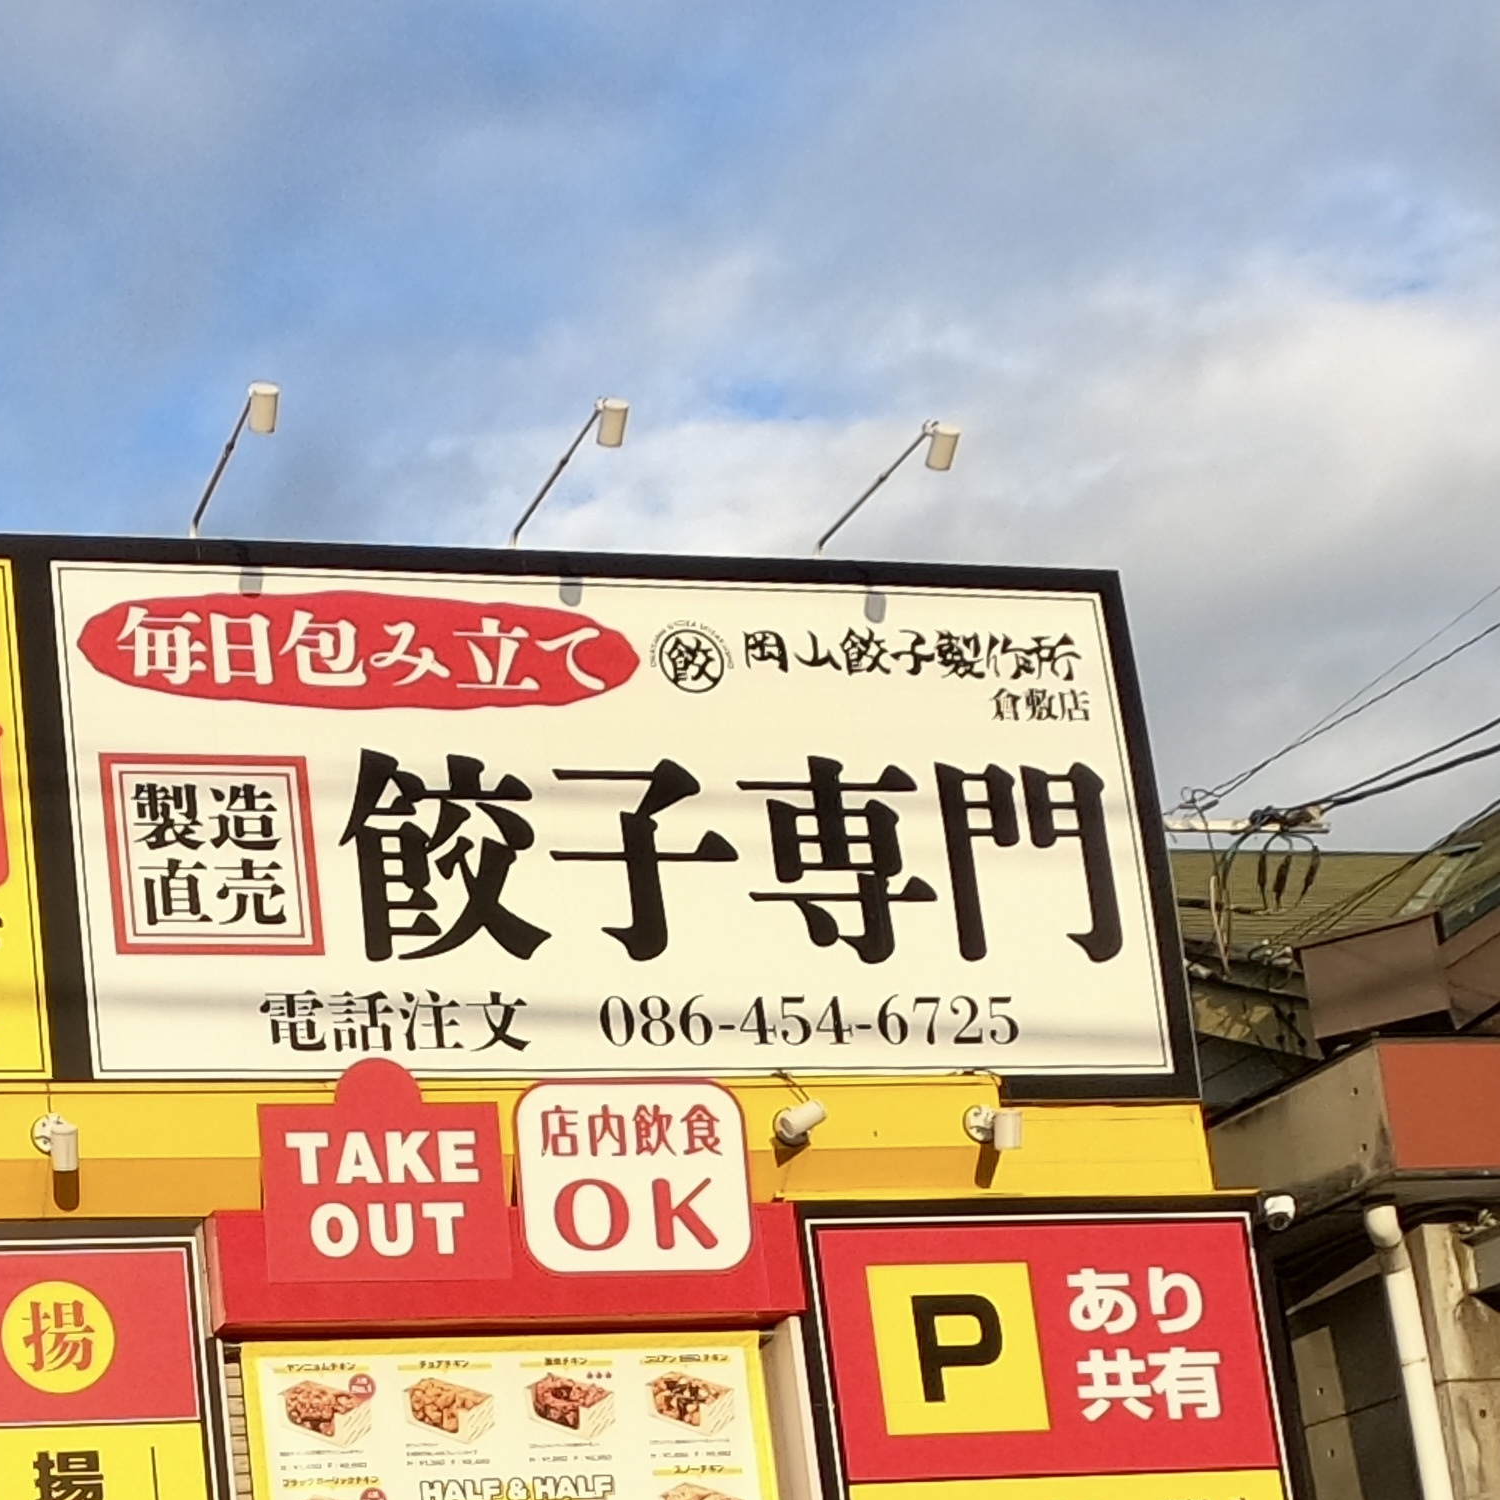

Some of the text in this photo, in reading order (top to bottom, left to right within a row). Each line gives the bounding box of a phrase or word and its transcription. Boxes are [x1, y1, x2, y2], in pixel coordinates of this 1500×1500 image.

[116, 606, 607, 692] 毎日包み立て
[743, 627, 1083, 682] 岡山餃子製作所
[990, 688, 1091, 723] 倉敷店
[131, 783, 283, 852] 製造
[339, 747, 1124, 965] 餃子専門
[137, 858, 287, 927] 直売
[260, 989, 1020, 1053] 電話注文 086-454-6725
[285, 1130, 481, 1186] TAKE
[541, 1103, 724, 1159] 店内飲食
[310, 1201, 466, 1258] OUT
[554, 1177, 720, 1251] OK
[1066, 1265, 1204, 1336] あり
[21, 1299, 96, 1374] 揚
[910, 1293, 1003, 1403] P
[1076, 1346, 1222, 1422] 共有
